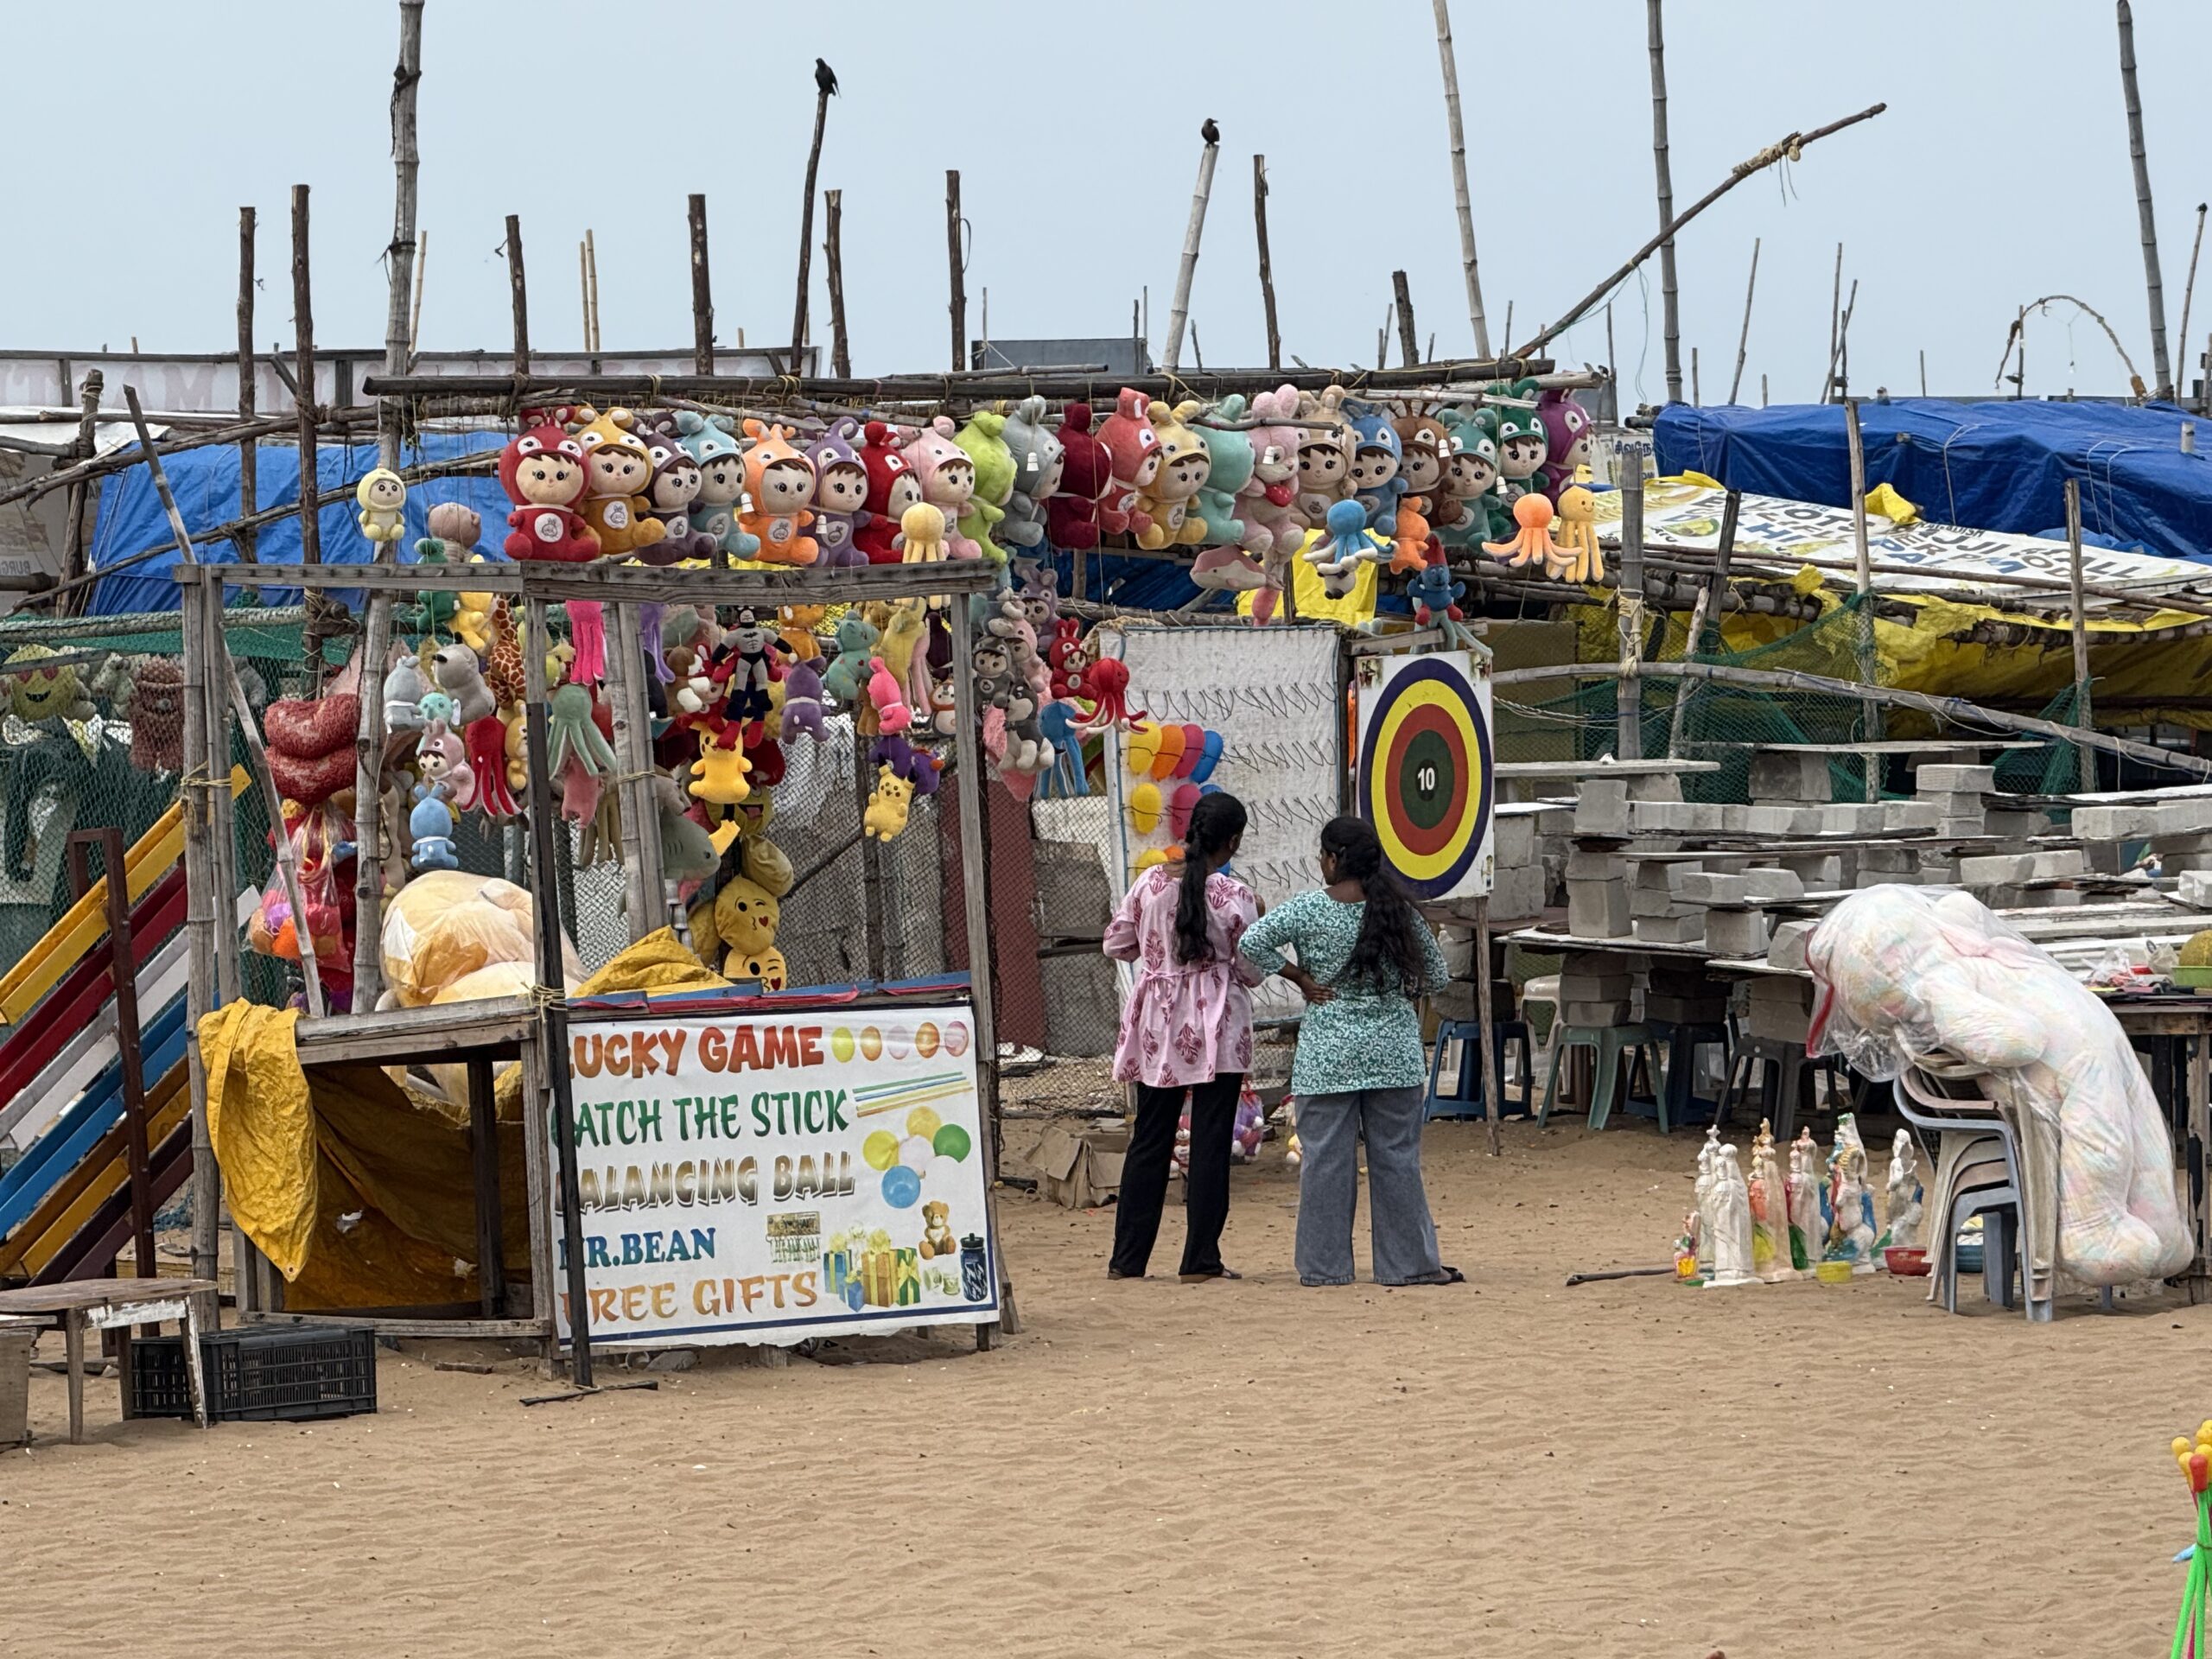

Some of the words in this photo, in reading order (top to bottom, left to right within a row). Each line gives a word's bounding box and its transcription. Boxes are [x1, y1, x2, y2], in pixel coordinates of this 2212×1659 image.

[1417, 767, 1435, 791] 10
[569, 1028, 688, 1079] UCKY
[698, 1024, 825, 1072] GAME
[672, 1095, 742, 1141] THE
[751, 1089, 849, 1136] STICK
[773, 1151, 856, 1201] BALL
[692, 1271, 818, 1318] GIFTS
